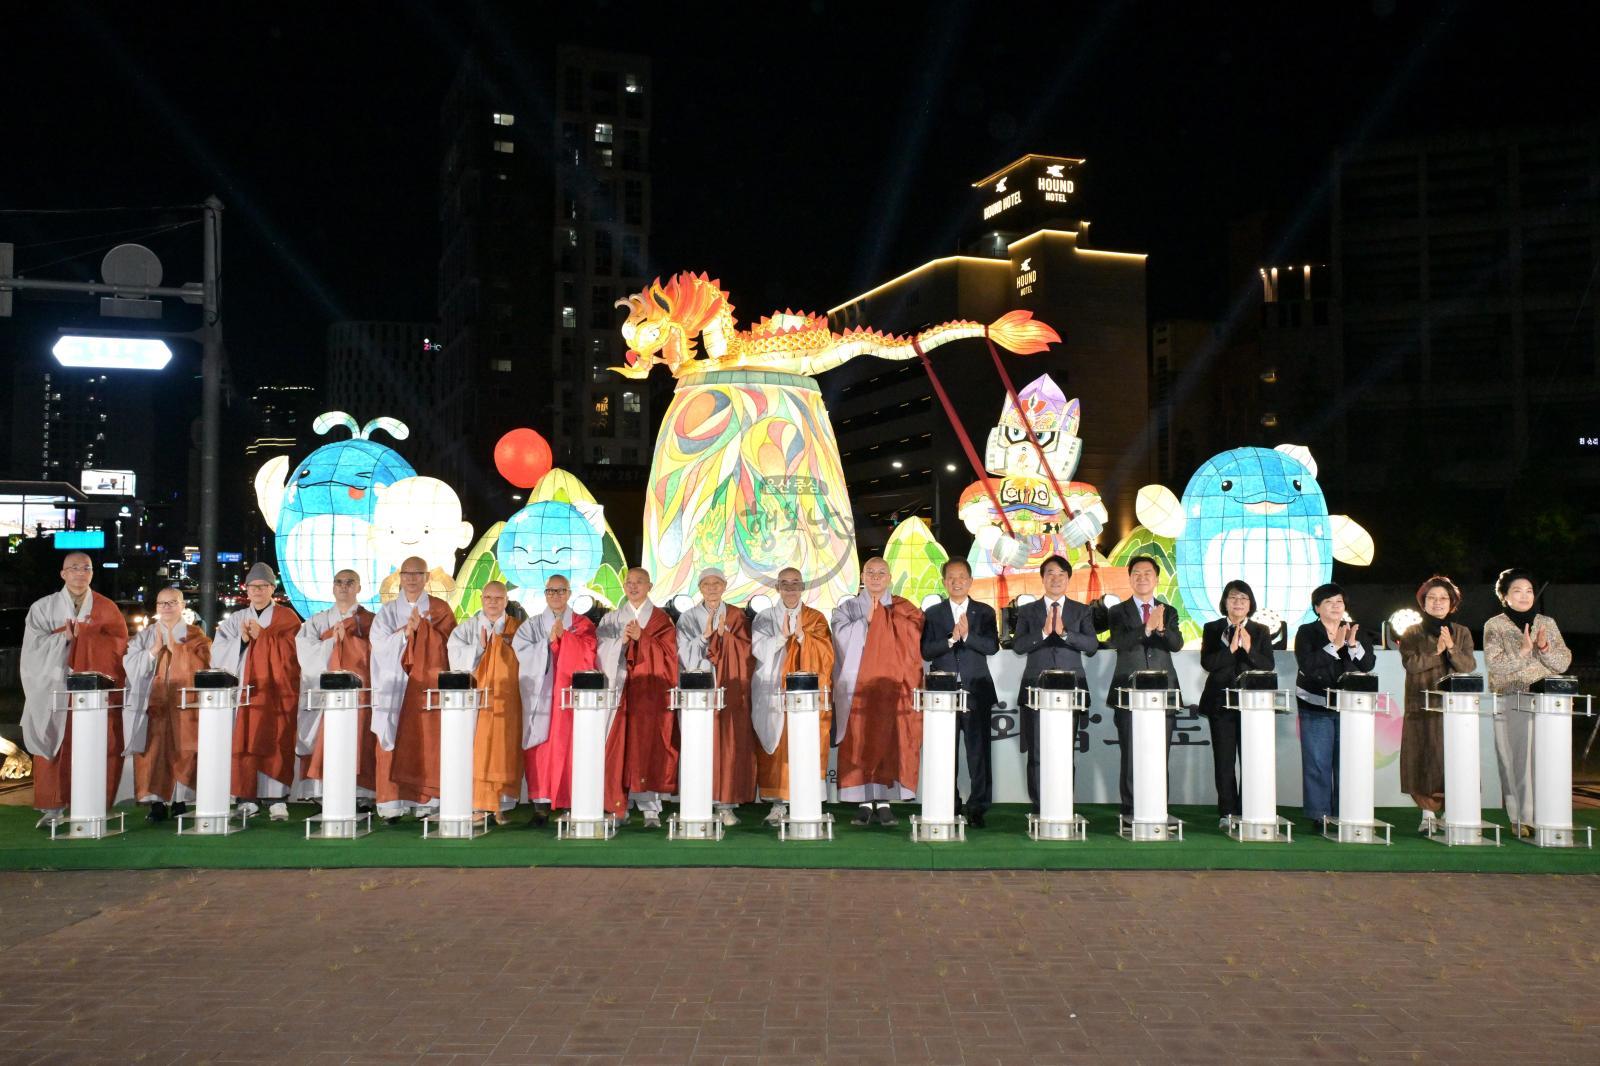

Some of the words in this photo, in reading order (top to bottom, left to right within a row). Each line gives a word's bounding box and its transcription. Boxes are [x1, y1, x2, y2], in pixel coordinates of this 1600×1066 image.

[1038, 177, 1074, 194] HOUND
[984, 200, 1002, 220] HOUND
[1002, 190, 1022, 210] HOTEL
[1045, 192, 1067, 203] HOTEL
[1016, 270, 1037, 289] HOUND
[1020, 285, 1033, 297] HOTEL
